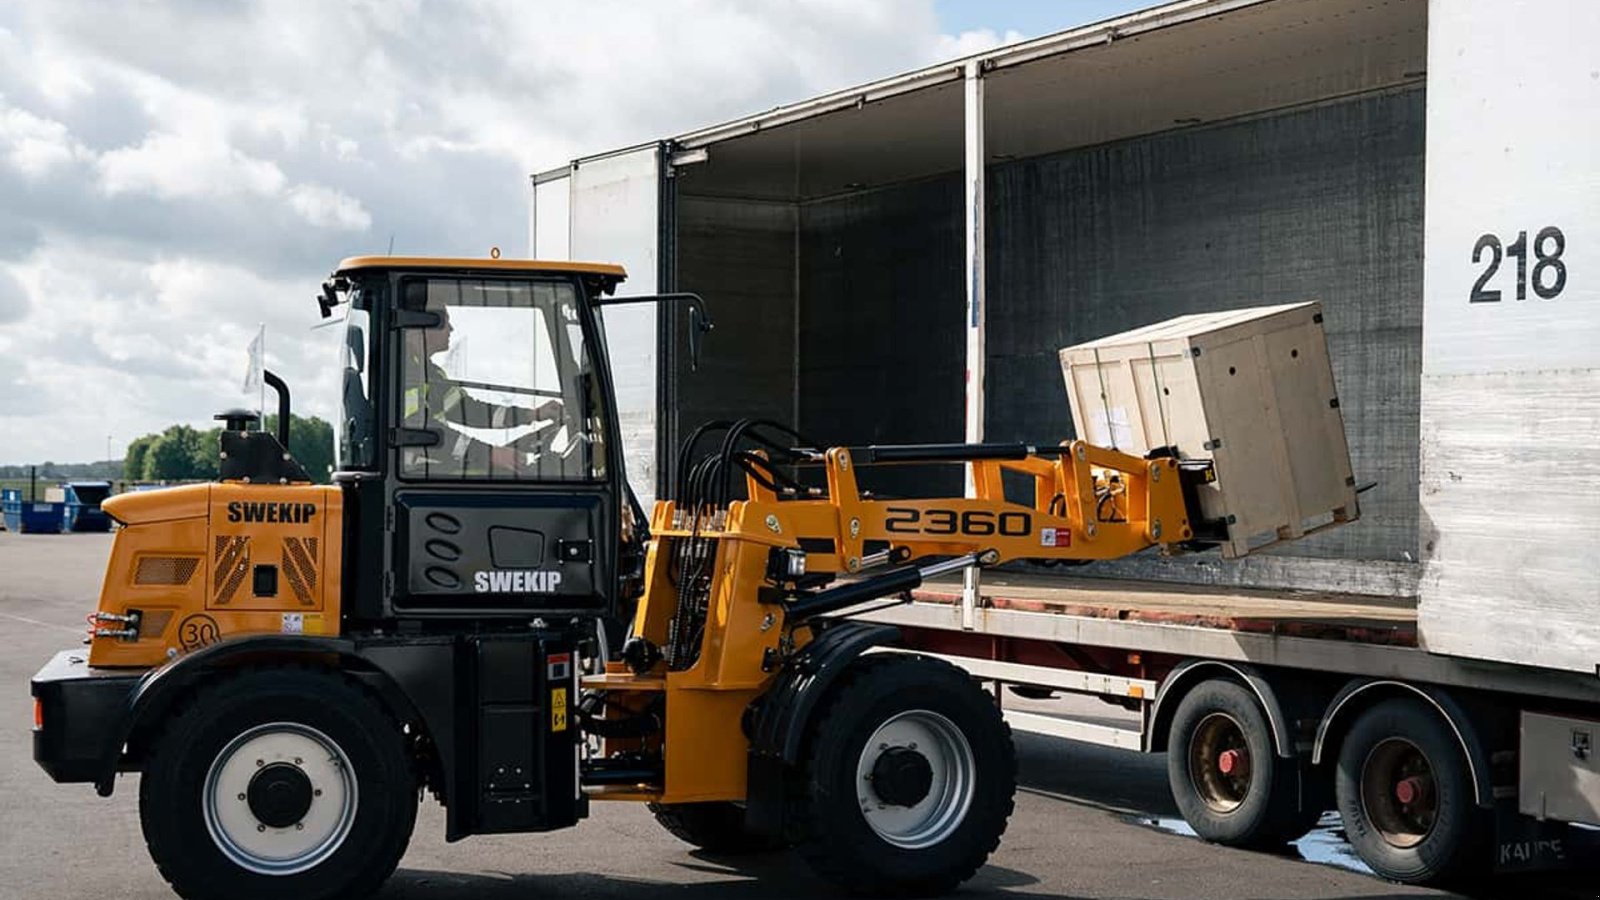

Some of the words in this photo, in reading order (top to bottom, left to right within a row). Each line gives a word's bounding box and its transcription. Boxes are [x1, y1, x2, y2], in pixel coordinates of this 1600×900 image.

[1469, 226, 1567, 303] 218
[228, 501, 316, 524] SWEKIP
[885, 507, 1032, 537] 2360
[474, 571, 561, 592] SWEKIP
[185, 623, 214, 645] 30
